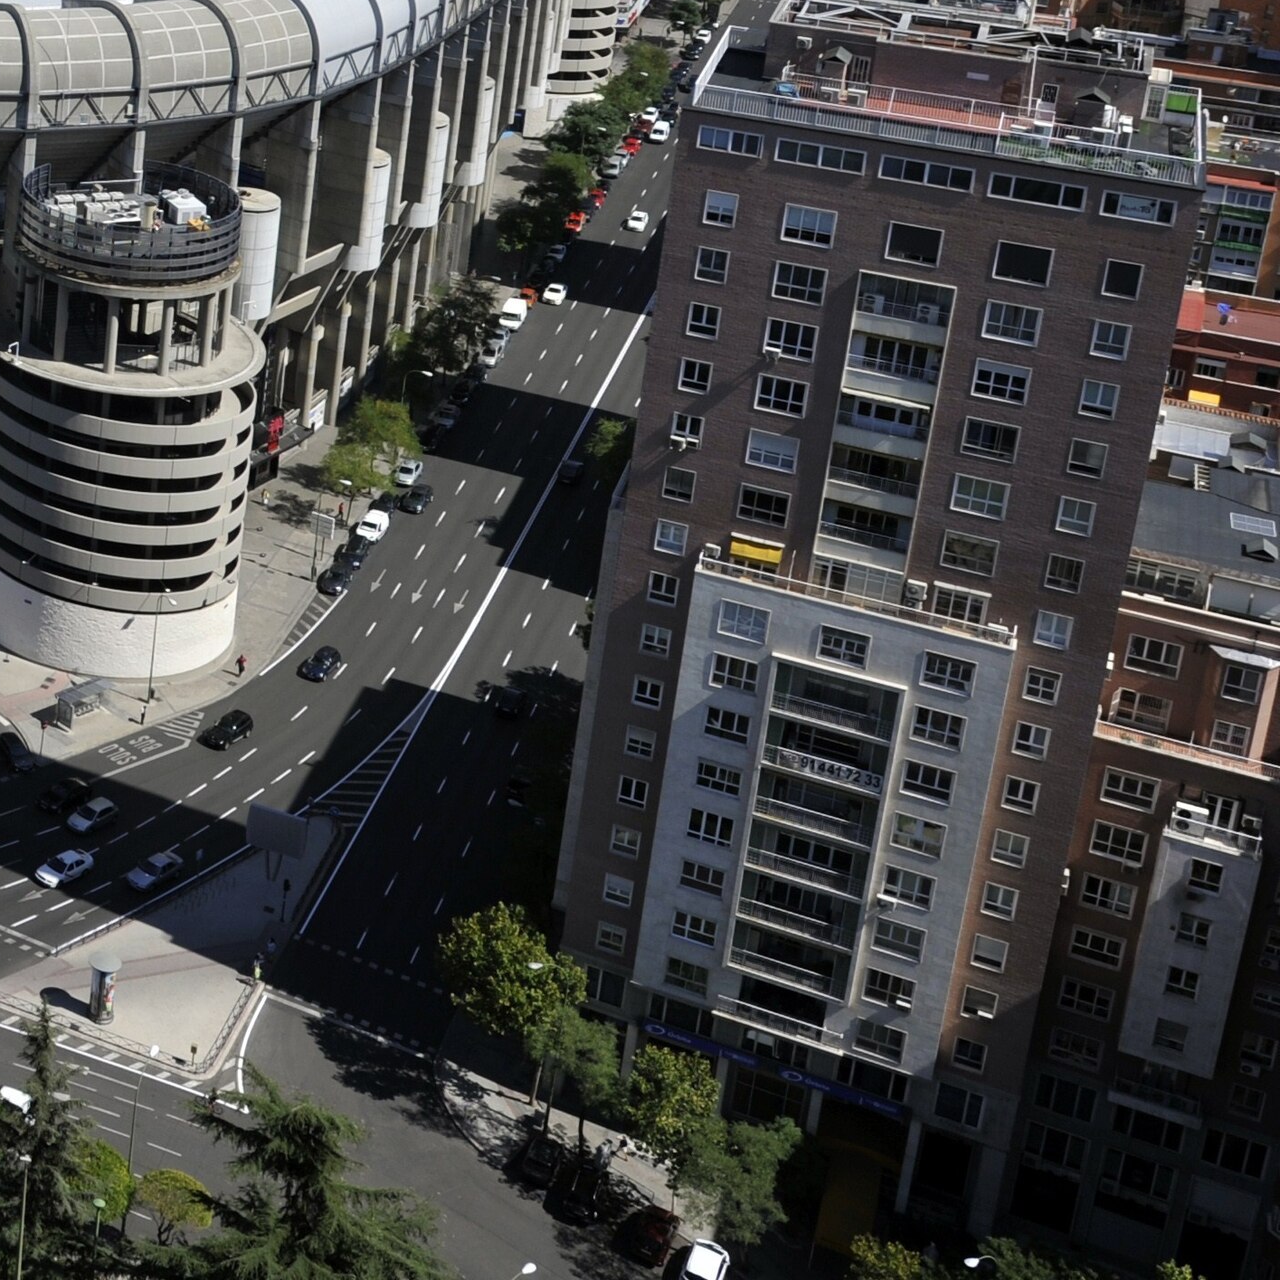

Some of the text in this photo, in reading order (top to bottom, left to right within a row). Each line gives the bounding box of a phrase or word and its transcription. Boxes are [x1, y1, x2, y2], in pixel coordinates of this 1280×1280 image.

[98, 743, 138, 765] SOLO
[128, 735, 163, 753] BUS
[800, 757, 816, 771] 91
[818, 762, 842, 777] 441
[845, 768, 860, 782] 72
[864, 774, 880, 788] 33
